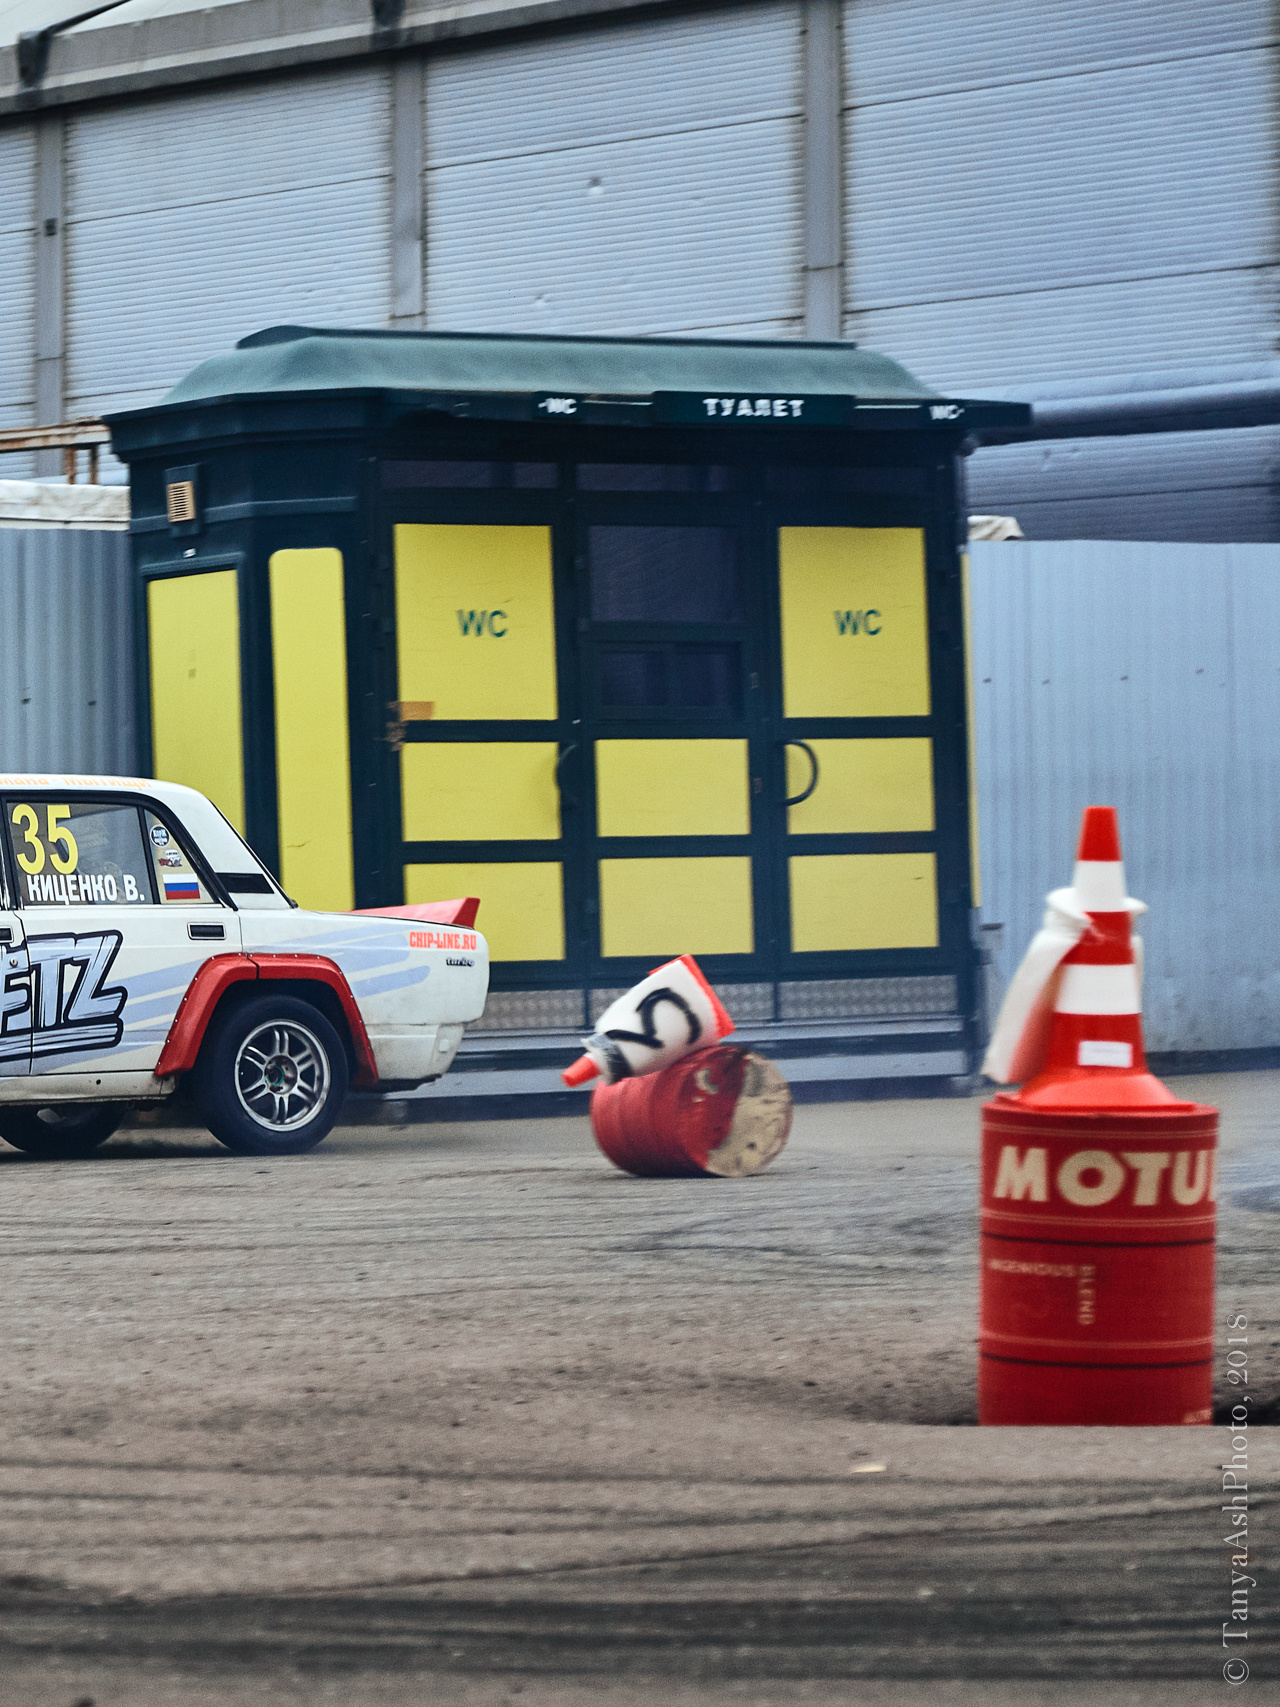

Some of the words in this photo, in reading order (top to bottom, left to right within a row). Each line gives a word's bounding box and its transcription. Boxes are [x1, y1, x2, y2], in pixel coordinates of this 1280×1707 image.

[702, 397, 805, 417] ТУАЛЕТ
[456, 608, 510, 638] WC
[834, 608, 883, 637] WC
[12, 803, 79, 875] 35
[26, 874, 118, 905] КИЦЕНКО
[123, 874, 146, 901] В.
[408, 931, 477, 951] CHIP-LINE.RU
[993, 1145, 1217, 1207] MOTU
